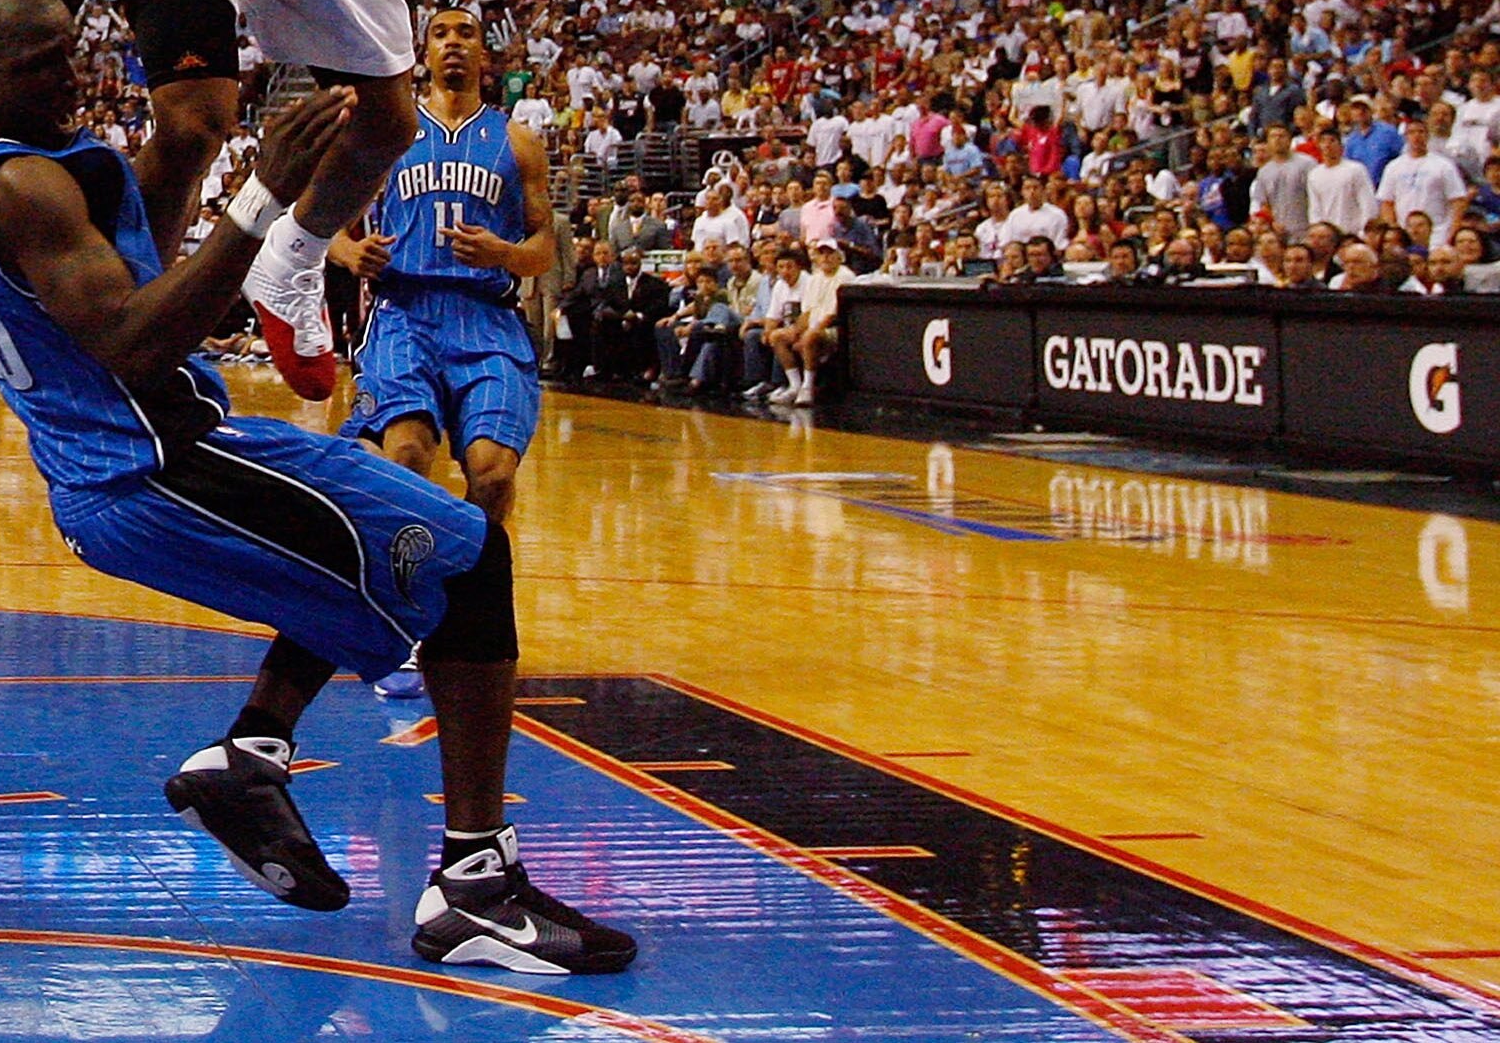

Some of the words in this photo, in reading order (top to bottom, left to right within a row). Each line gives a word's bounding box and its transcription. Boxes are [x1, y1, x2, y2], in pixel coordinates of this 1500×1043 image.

[398, 161, 503, 206] ORLANDO
[433, 201, 464, 248] 11
[922, 318, 951, 386] G
[1043, 335, 1263, 407] GATORADE
[1409, 342, 1464, 434] G
